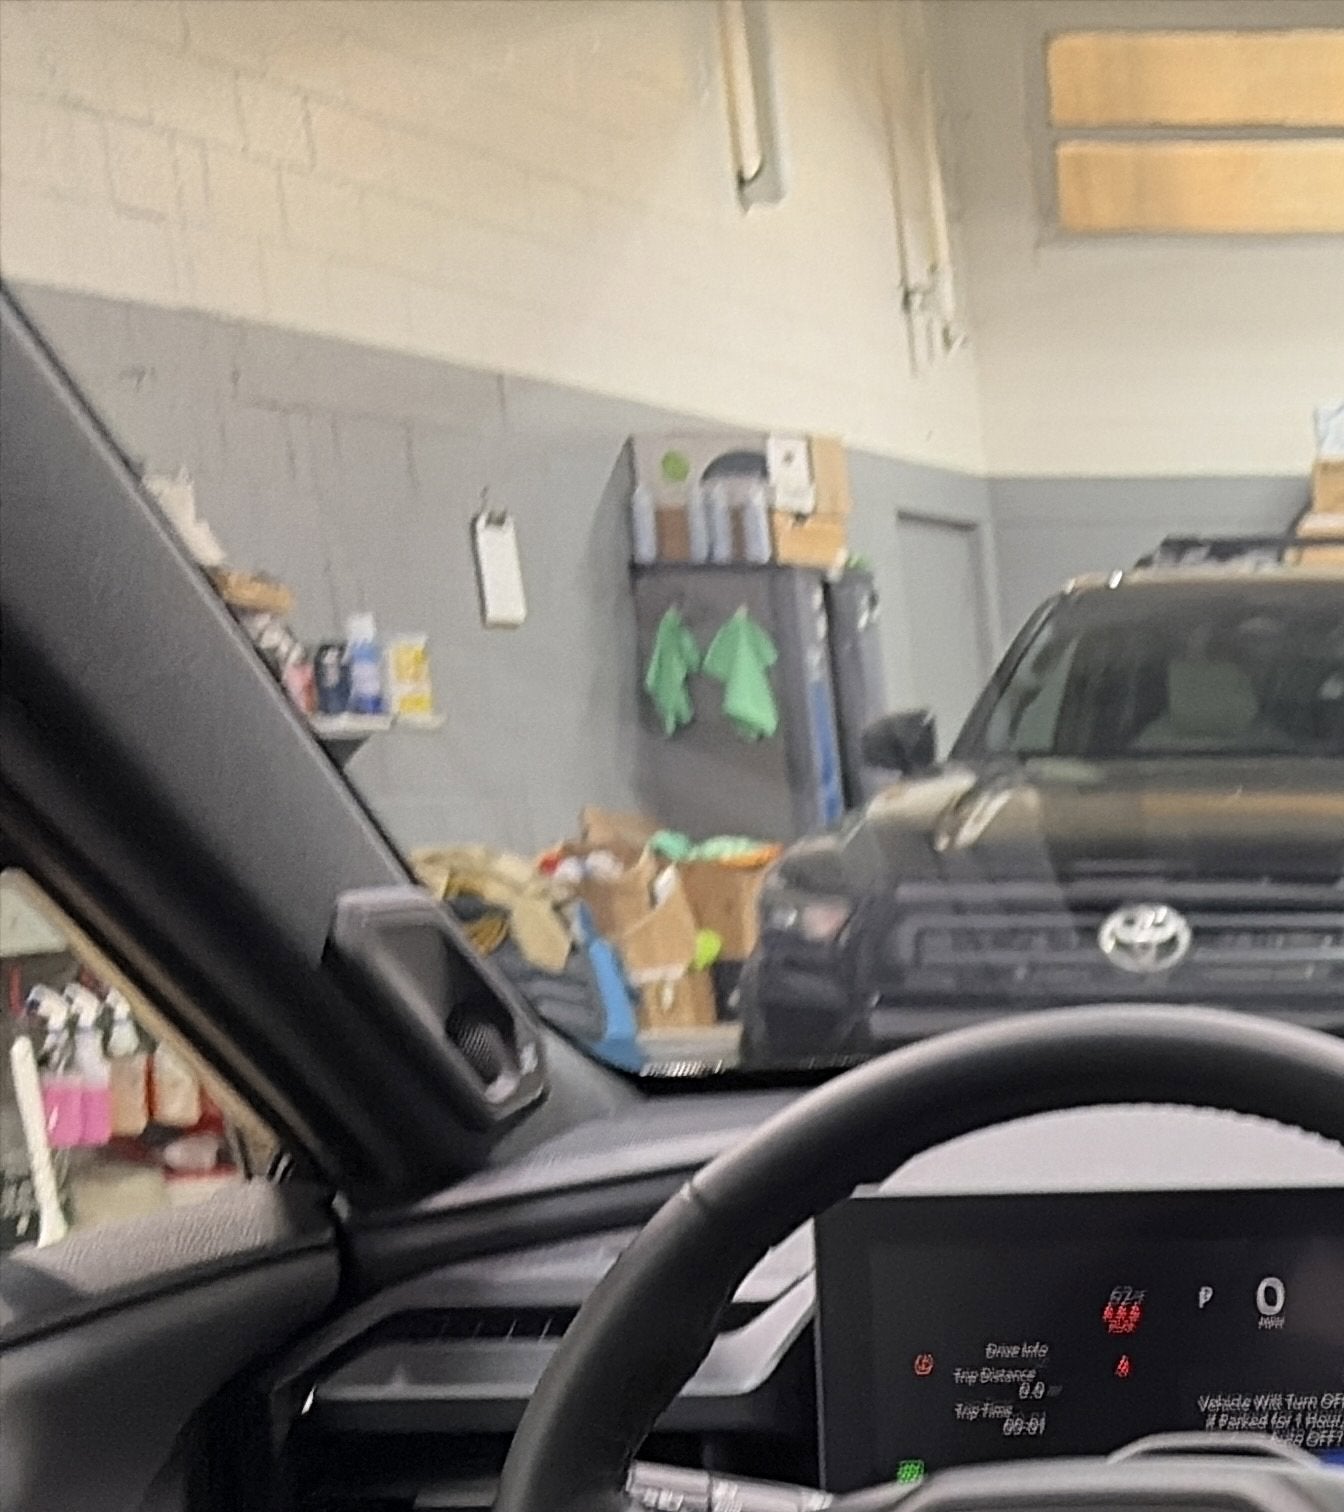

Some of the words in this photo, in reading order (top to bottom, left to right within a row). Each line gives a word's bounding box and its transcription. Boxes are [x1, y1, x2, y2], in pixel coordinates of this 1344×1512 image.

[953, 1367, 978, 1386] Trip
[979, 1367, 1037, 1384] Distance
[1198, 1394, 1251, 1412] Vehicle
[1253, 1392, 1282, 1411] Will
[1284, 1392, 1317, 1410] Turn
